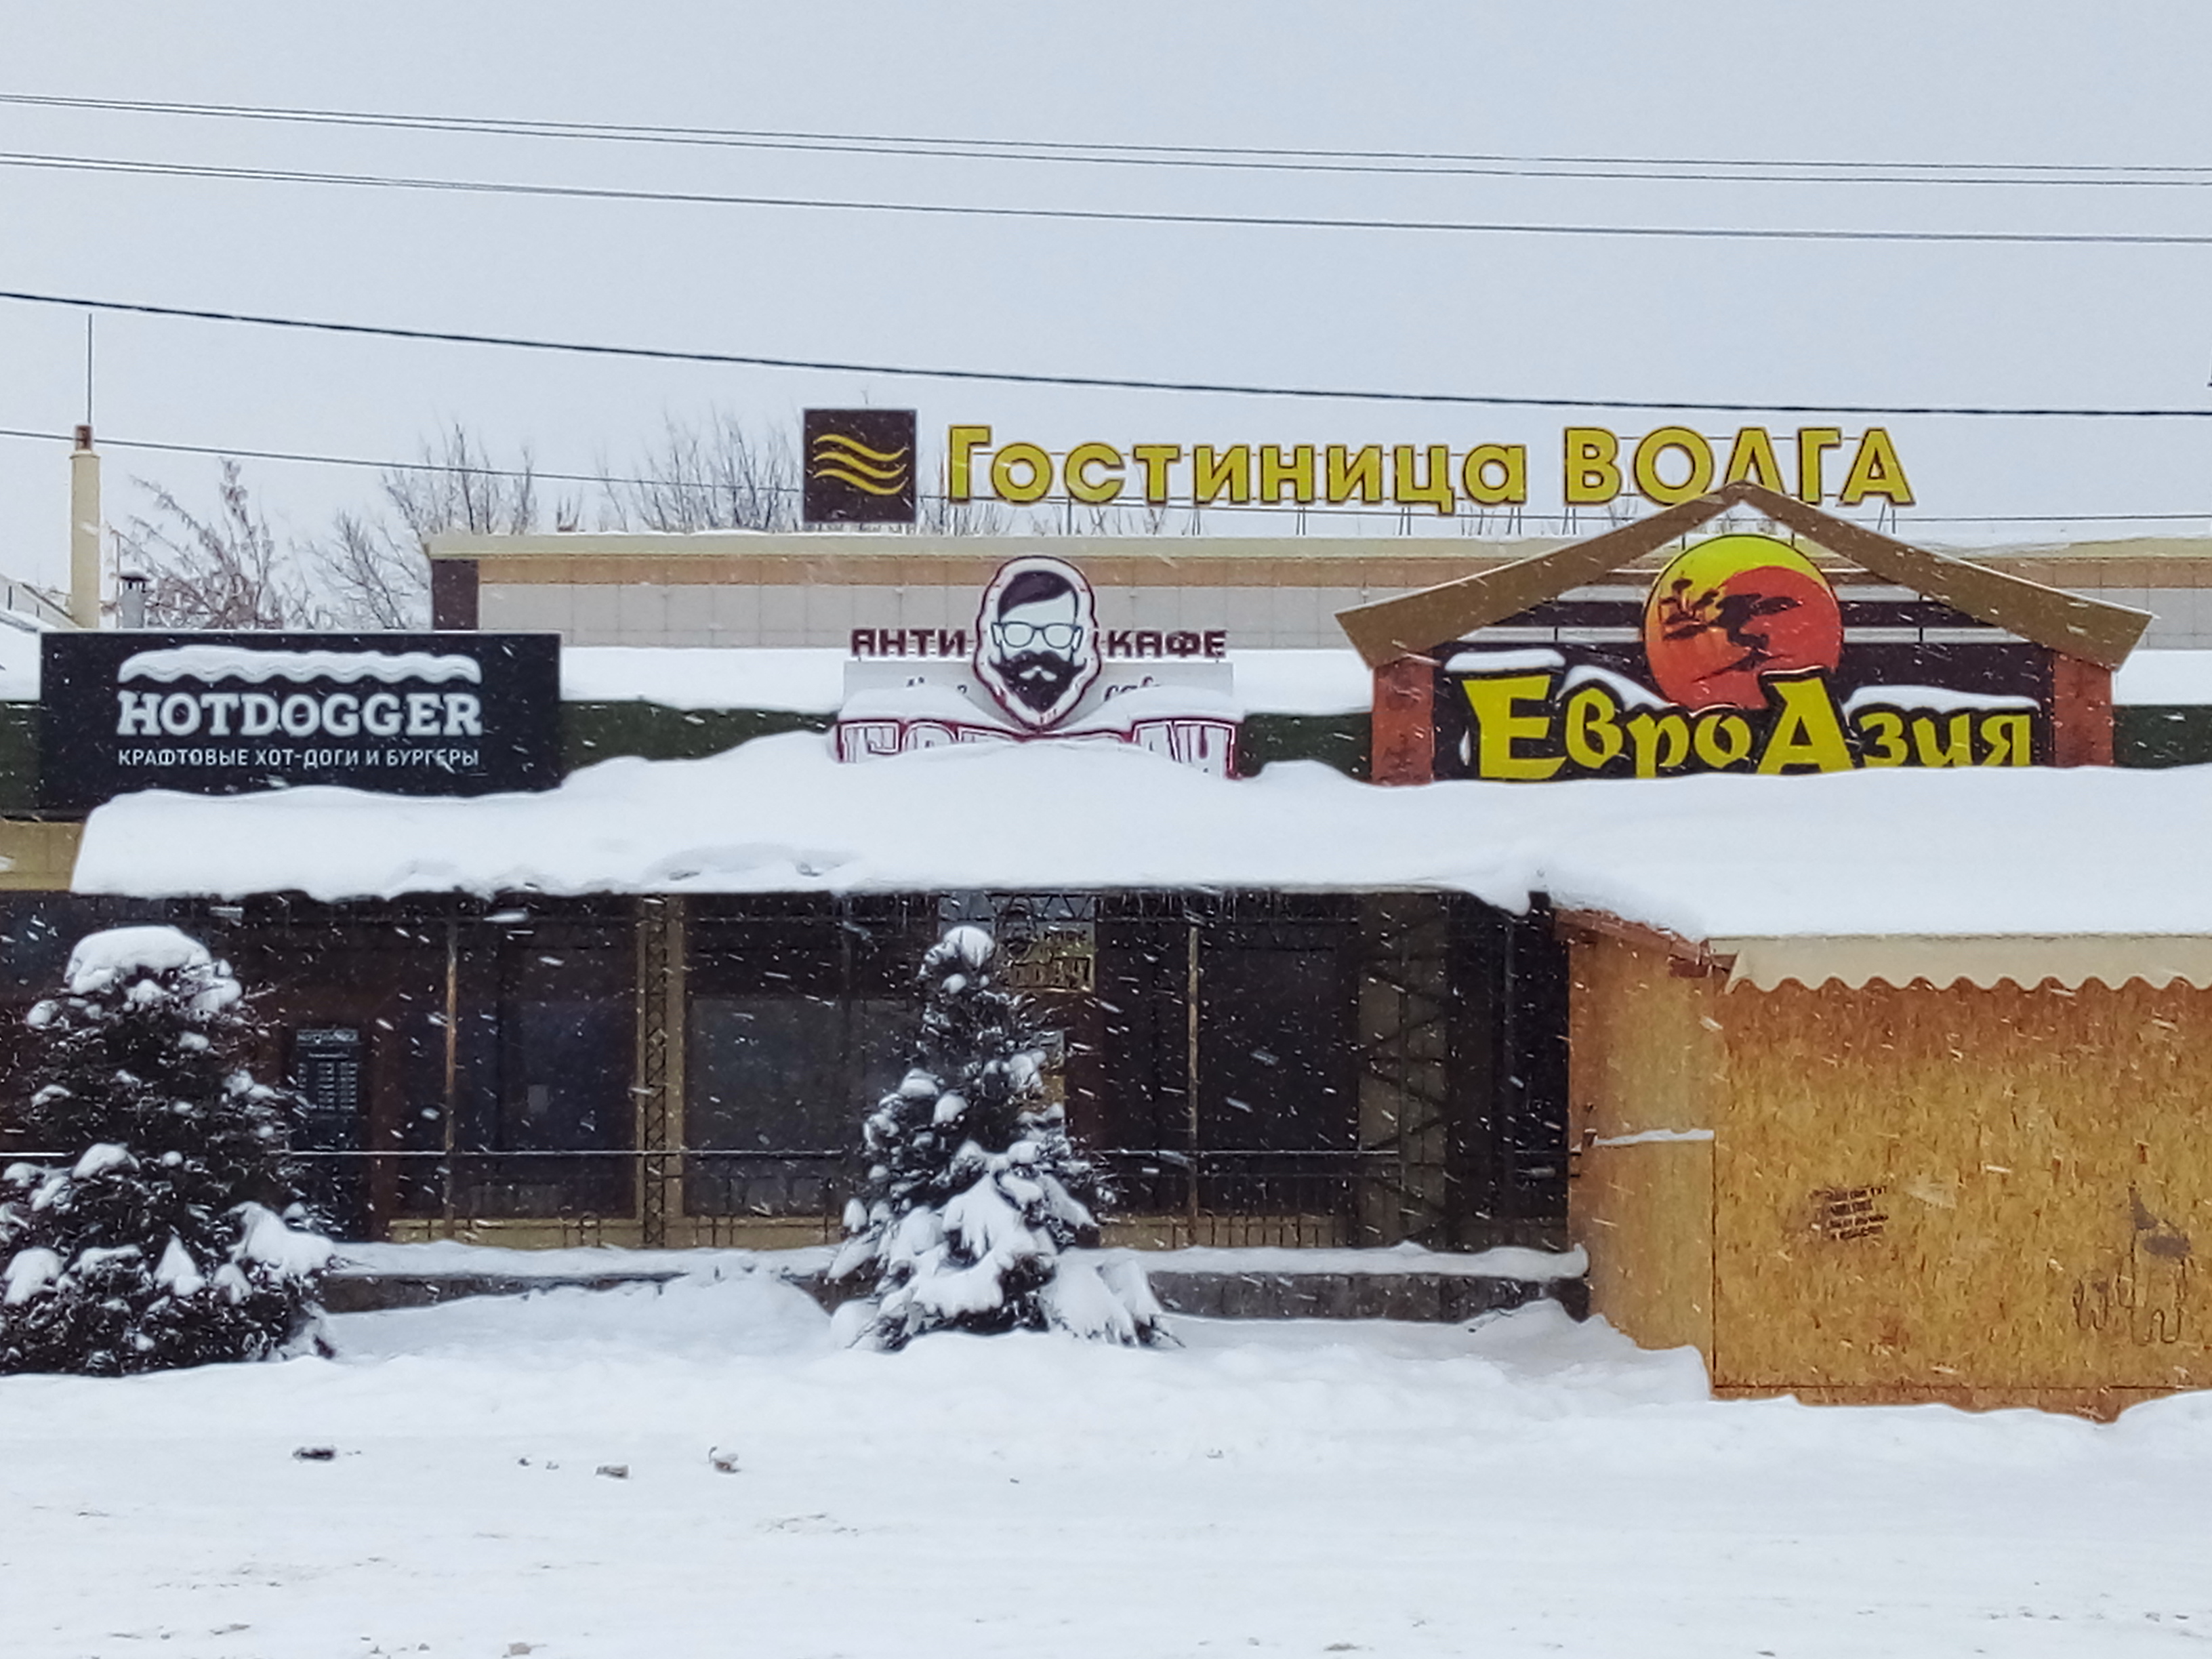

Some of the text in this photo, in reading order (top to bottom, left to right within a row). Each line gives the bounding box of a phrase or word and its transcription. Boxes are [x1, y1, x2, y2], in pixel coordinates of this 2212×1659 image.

[948, 425, 1917, 516] Гостиница ВОЛГА
[851, 628, 1227, 658] АНТИ КАФЕ
[117, 690, 483, 737] HOTDOGGER
[1462, 674, 2032, 780] ЕвроАзия
[118, 748, 480, 770] КРАФТОВЫЕ ХОТ-ДОГИ И БУРГЕРЫ
